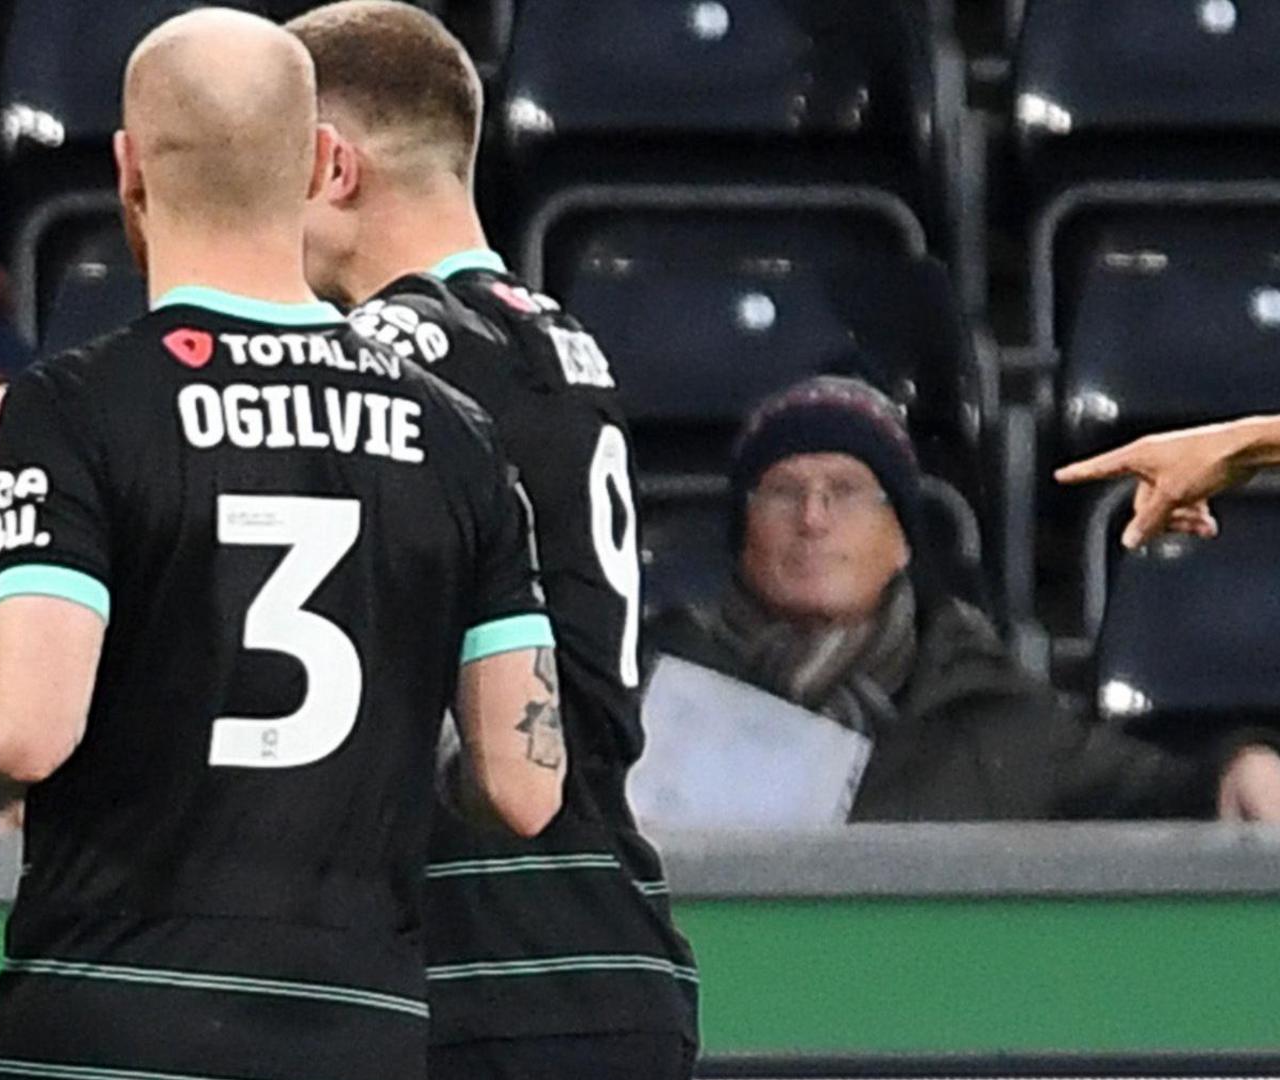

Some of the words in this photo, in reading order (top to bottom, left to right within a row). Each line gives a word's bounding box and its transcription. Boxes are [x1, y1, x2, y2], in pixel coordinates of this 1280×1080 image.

[177, 382, 426, 463] OGILVIE
[218, 332, 401, 380] TOTALAV
[207, 493, 363, 768] 3
[589, 422, 641, 688] 9
